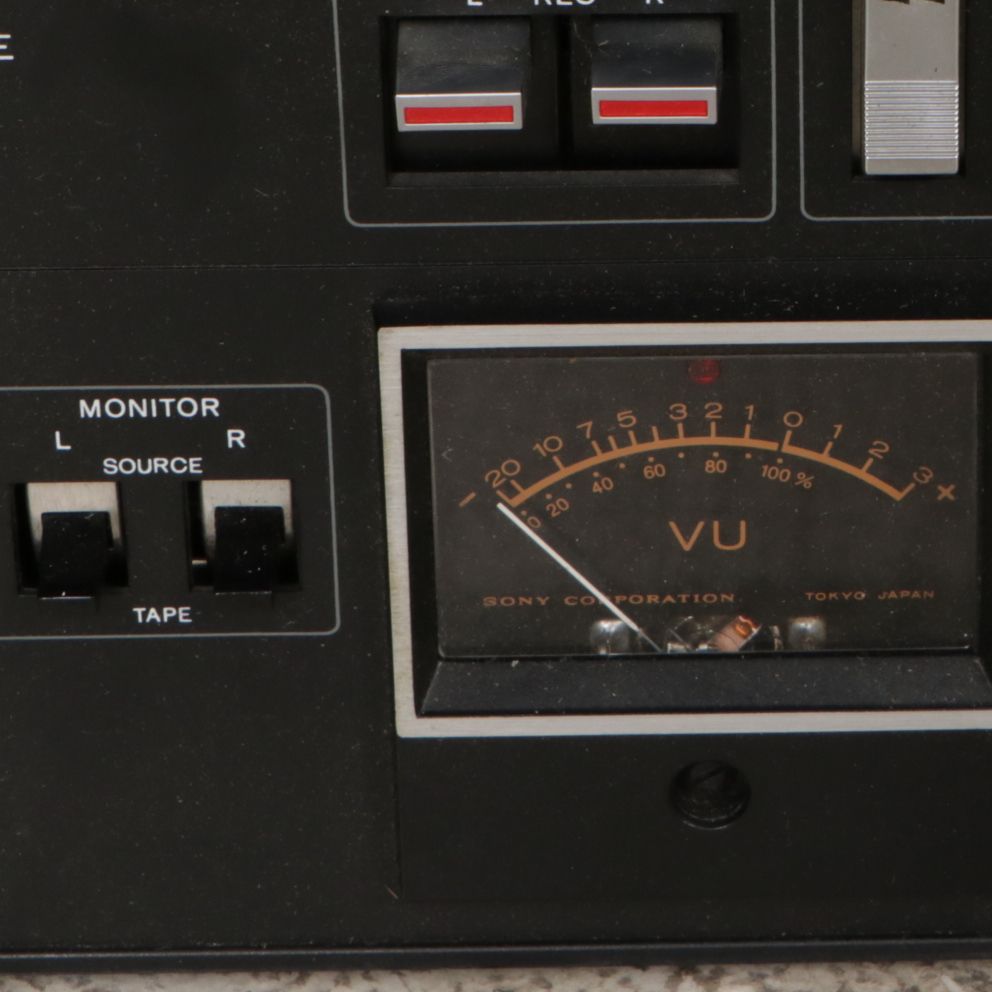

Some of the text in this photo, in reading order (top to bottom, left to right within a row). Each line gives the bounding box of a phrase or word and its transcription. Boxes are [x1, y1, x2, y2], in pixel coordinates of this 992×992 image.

[79, 397, 220, 419] MONITOR
[54, 428, 246, 451] L R
[484, 458, 521, 489] 20
[532, 435, 564, 458] 10
[575, 420, 594, 440] 7
[616, 409, 638, 429] 5
[668, 402, 688, 421] 3
[704, 401, 724, 420] 2
[745, 404, 755, 422] 1
[782, 410, 804, 428] 0
[832, 423, 843, 440] 1
[868, 440, 890, 460] 2
[912, 465, 935, 485] 3
[102, 456, 203, 476] SOURCE
[546, 497, 571, 519] 20
[592, 476, 615, 495] 40
[642, 463, 667, 480] 60
[704, 459, 729, 475] 80
[760, 464, 792, 483] 100
[668, 520, 748, 551] VU
[482, 592, 736, 608] SONY COPORATION
[805, 590, 935, 601] TOKYO JAPAN
[133, 606, 193, 624] TAPE
